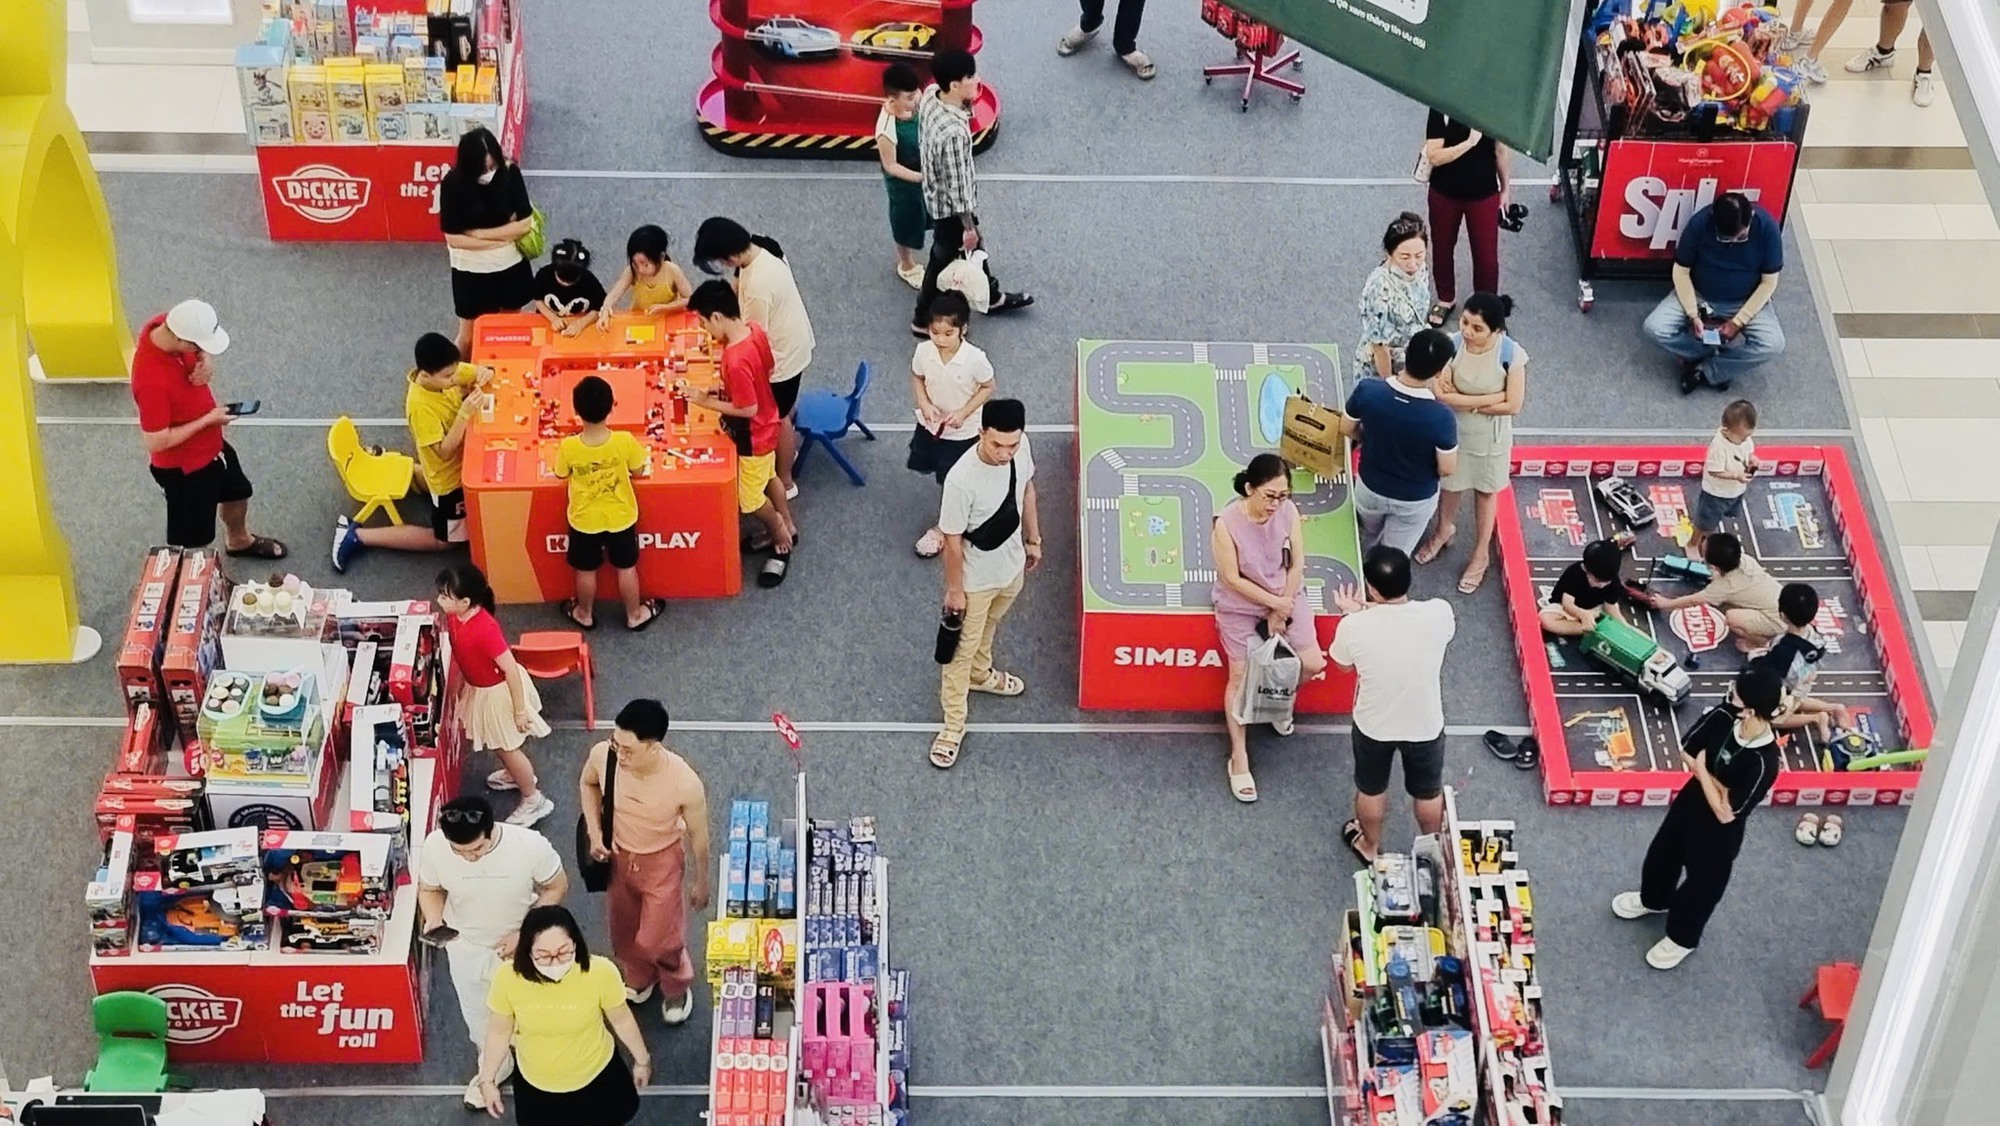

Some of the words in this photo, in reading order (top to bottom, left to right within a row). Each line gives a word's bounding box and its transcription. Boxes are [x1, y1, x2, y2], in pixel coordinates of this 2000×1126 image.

[400, 183, 428, 197] the
[1114, 647, 1223, 667] SIMBA
[297, 981, 344, 1001] Let
[280, 1003, 316, 1018] the
[318, 1003, 394, 1034] fun
[339, 1033, 376, 1048] roll
